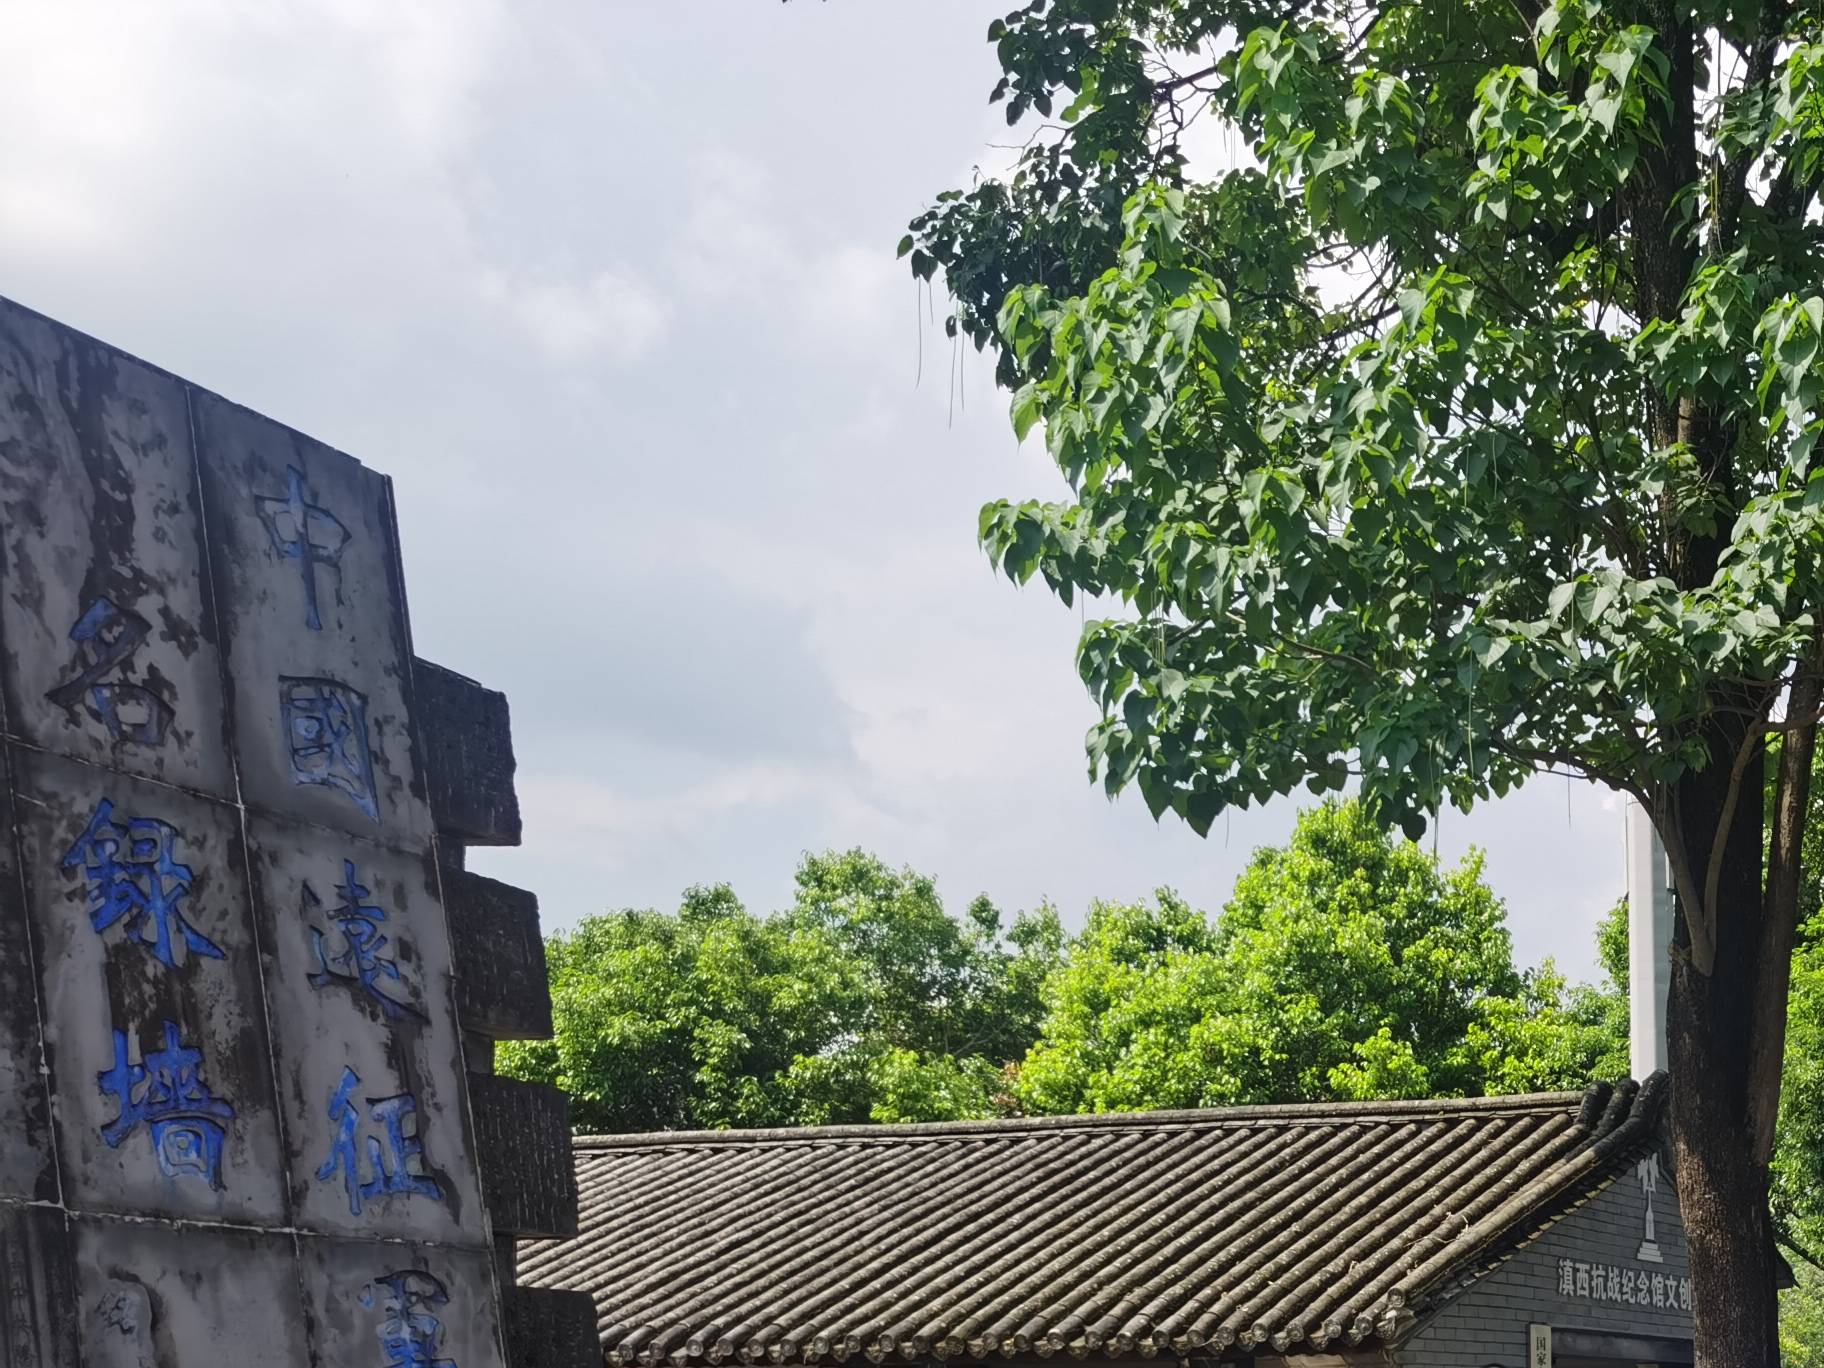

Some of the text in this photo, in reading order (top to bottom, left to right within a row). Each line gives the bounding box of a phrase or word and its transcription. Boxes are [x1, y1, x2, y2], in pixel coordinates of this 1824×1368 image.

[1558, 1259, 1692, 1310] 滇西抗战纪念馆文创
